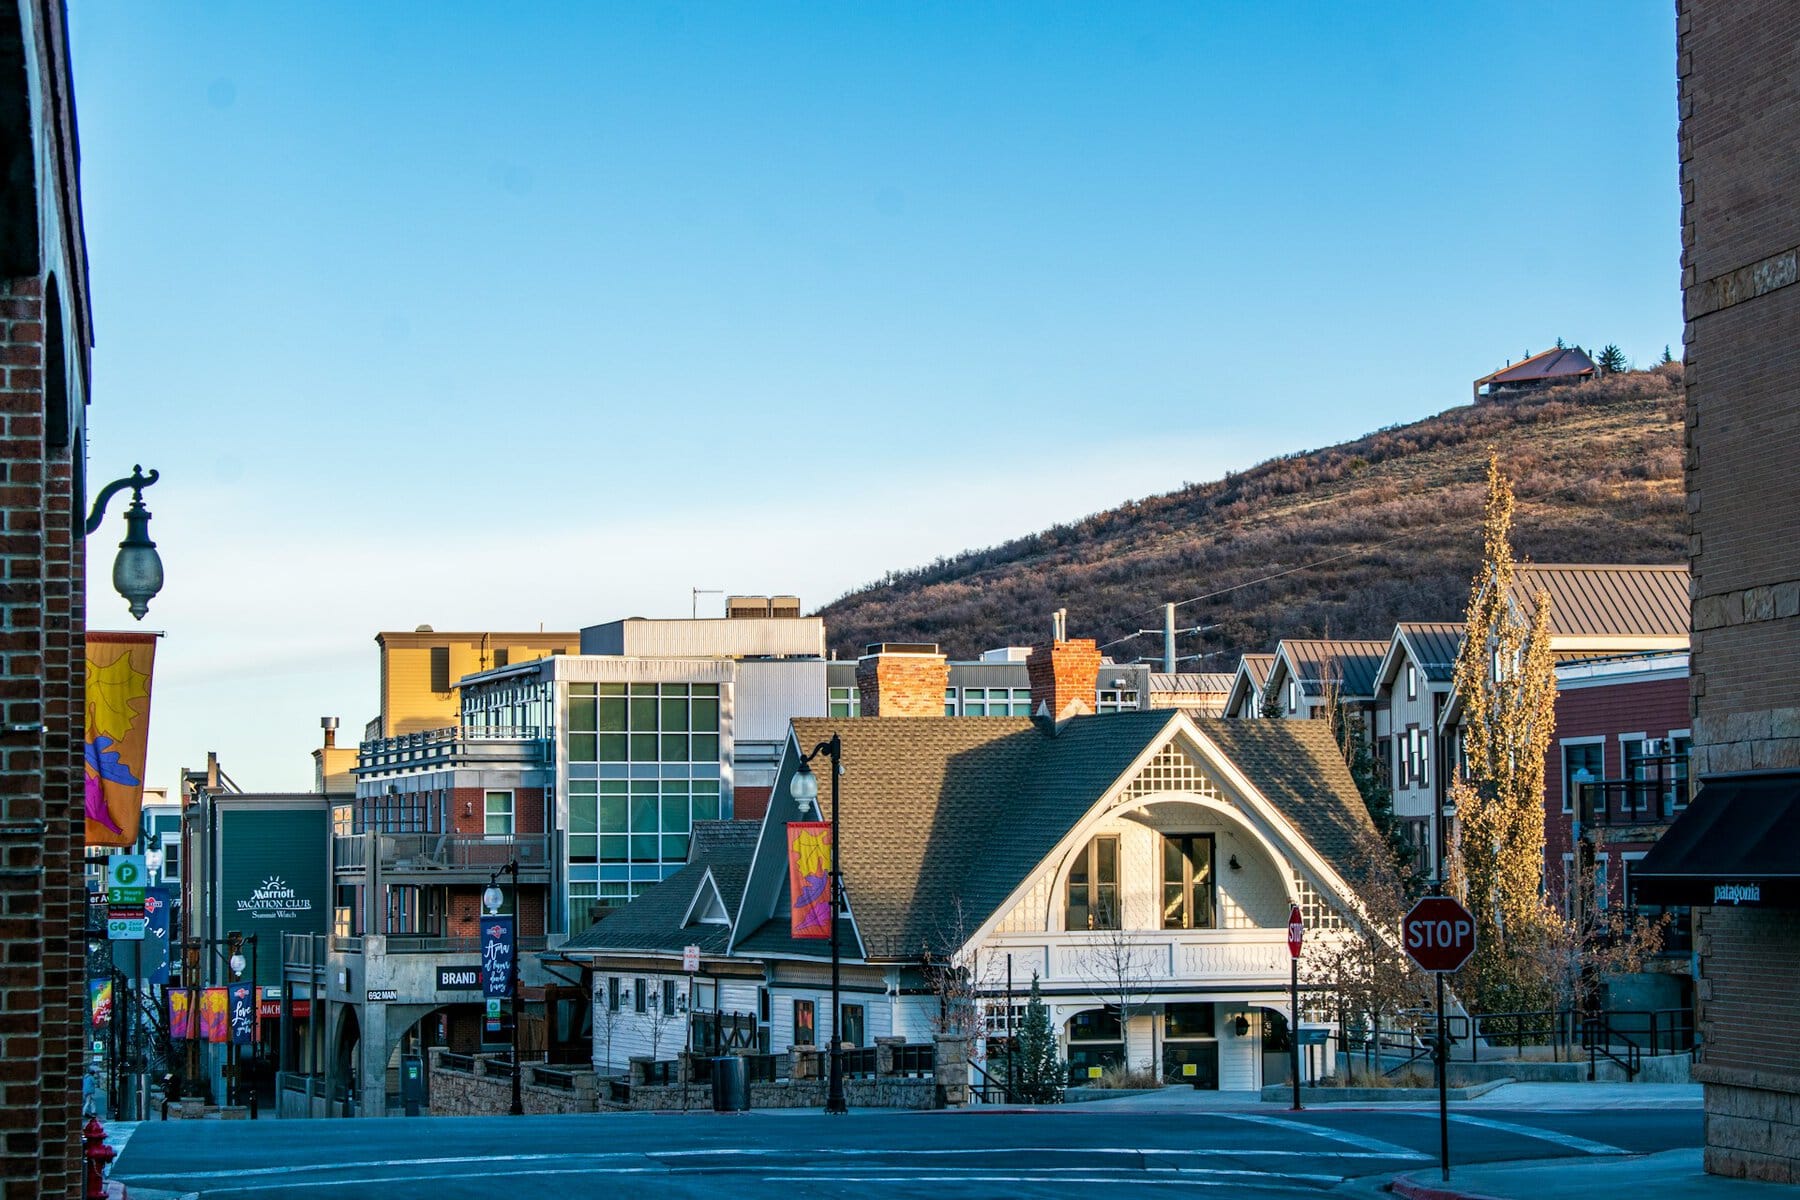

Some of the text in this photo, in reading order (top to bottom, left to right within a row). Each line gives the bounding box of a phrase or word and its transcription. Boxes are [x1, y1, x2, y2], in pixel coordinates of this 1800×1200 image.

[112, 889, 122, 902] 3
[251, 889, 296, 900] Marriott
[1713, 883, 1760, 905] patagonia
[236, 899, 312, 908] VACATION CLUB
[276, 910, 297, 918] Watch
[1408, 920, 1471, 948] STOP
[442, 971, 476, 985] BRAND
[368, 990, 397, 1000] 692 MAIN
[231, 1000, 252, 1026] Love
